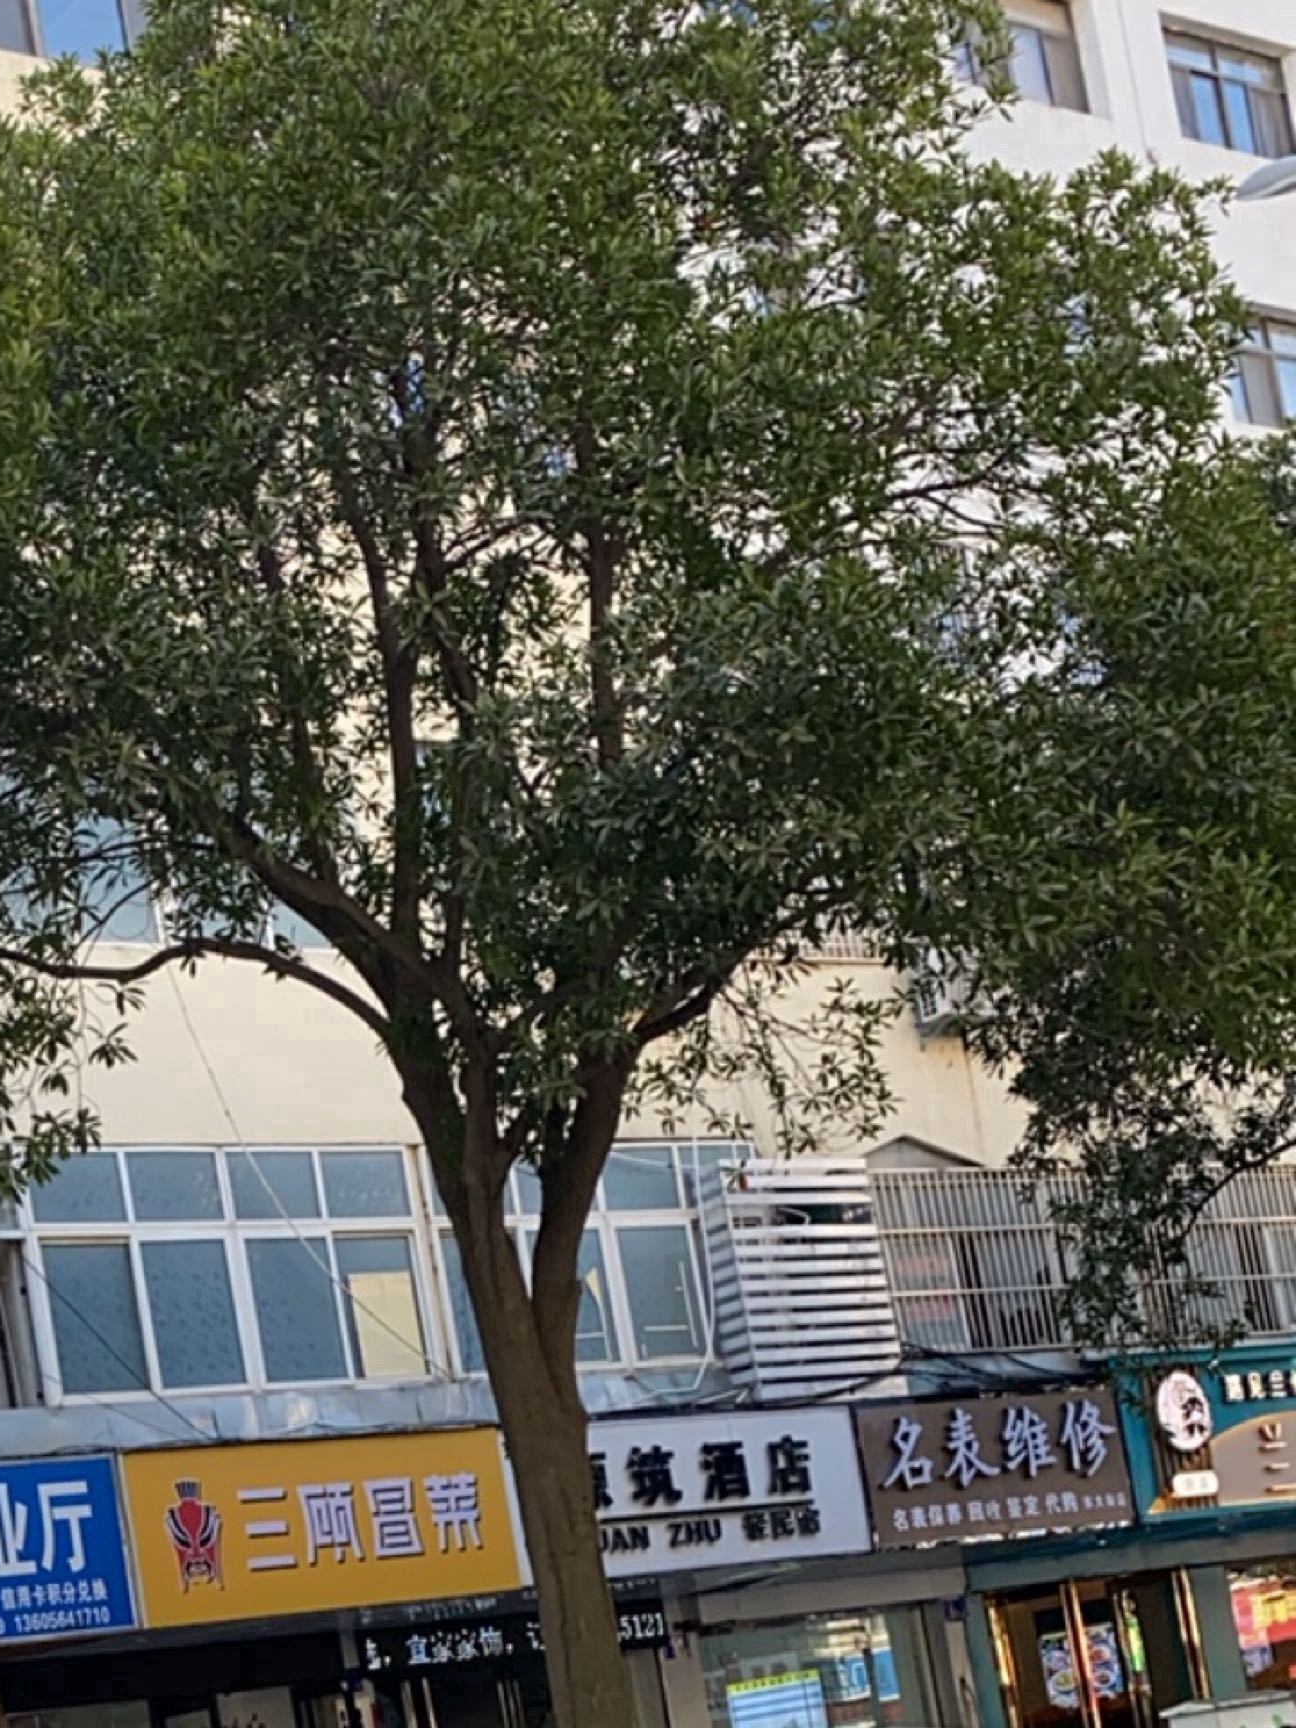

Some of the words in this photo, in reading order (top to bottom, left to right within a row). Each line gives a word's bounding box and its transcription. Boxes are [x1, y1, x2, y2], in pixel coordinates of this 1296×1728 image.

[881, 1400, 1117, 1491] 名表维修
[236, 1472, 484, 1572] 三顾冒菜
[666, 1518, 723, 1550] ZHU
